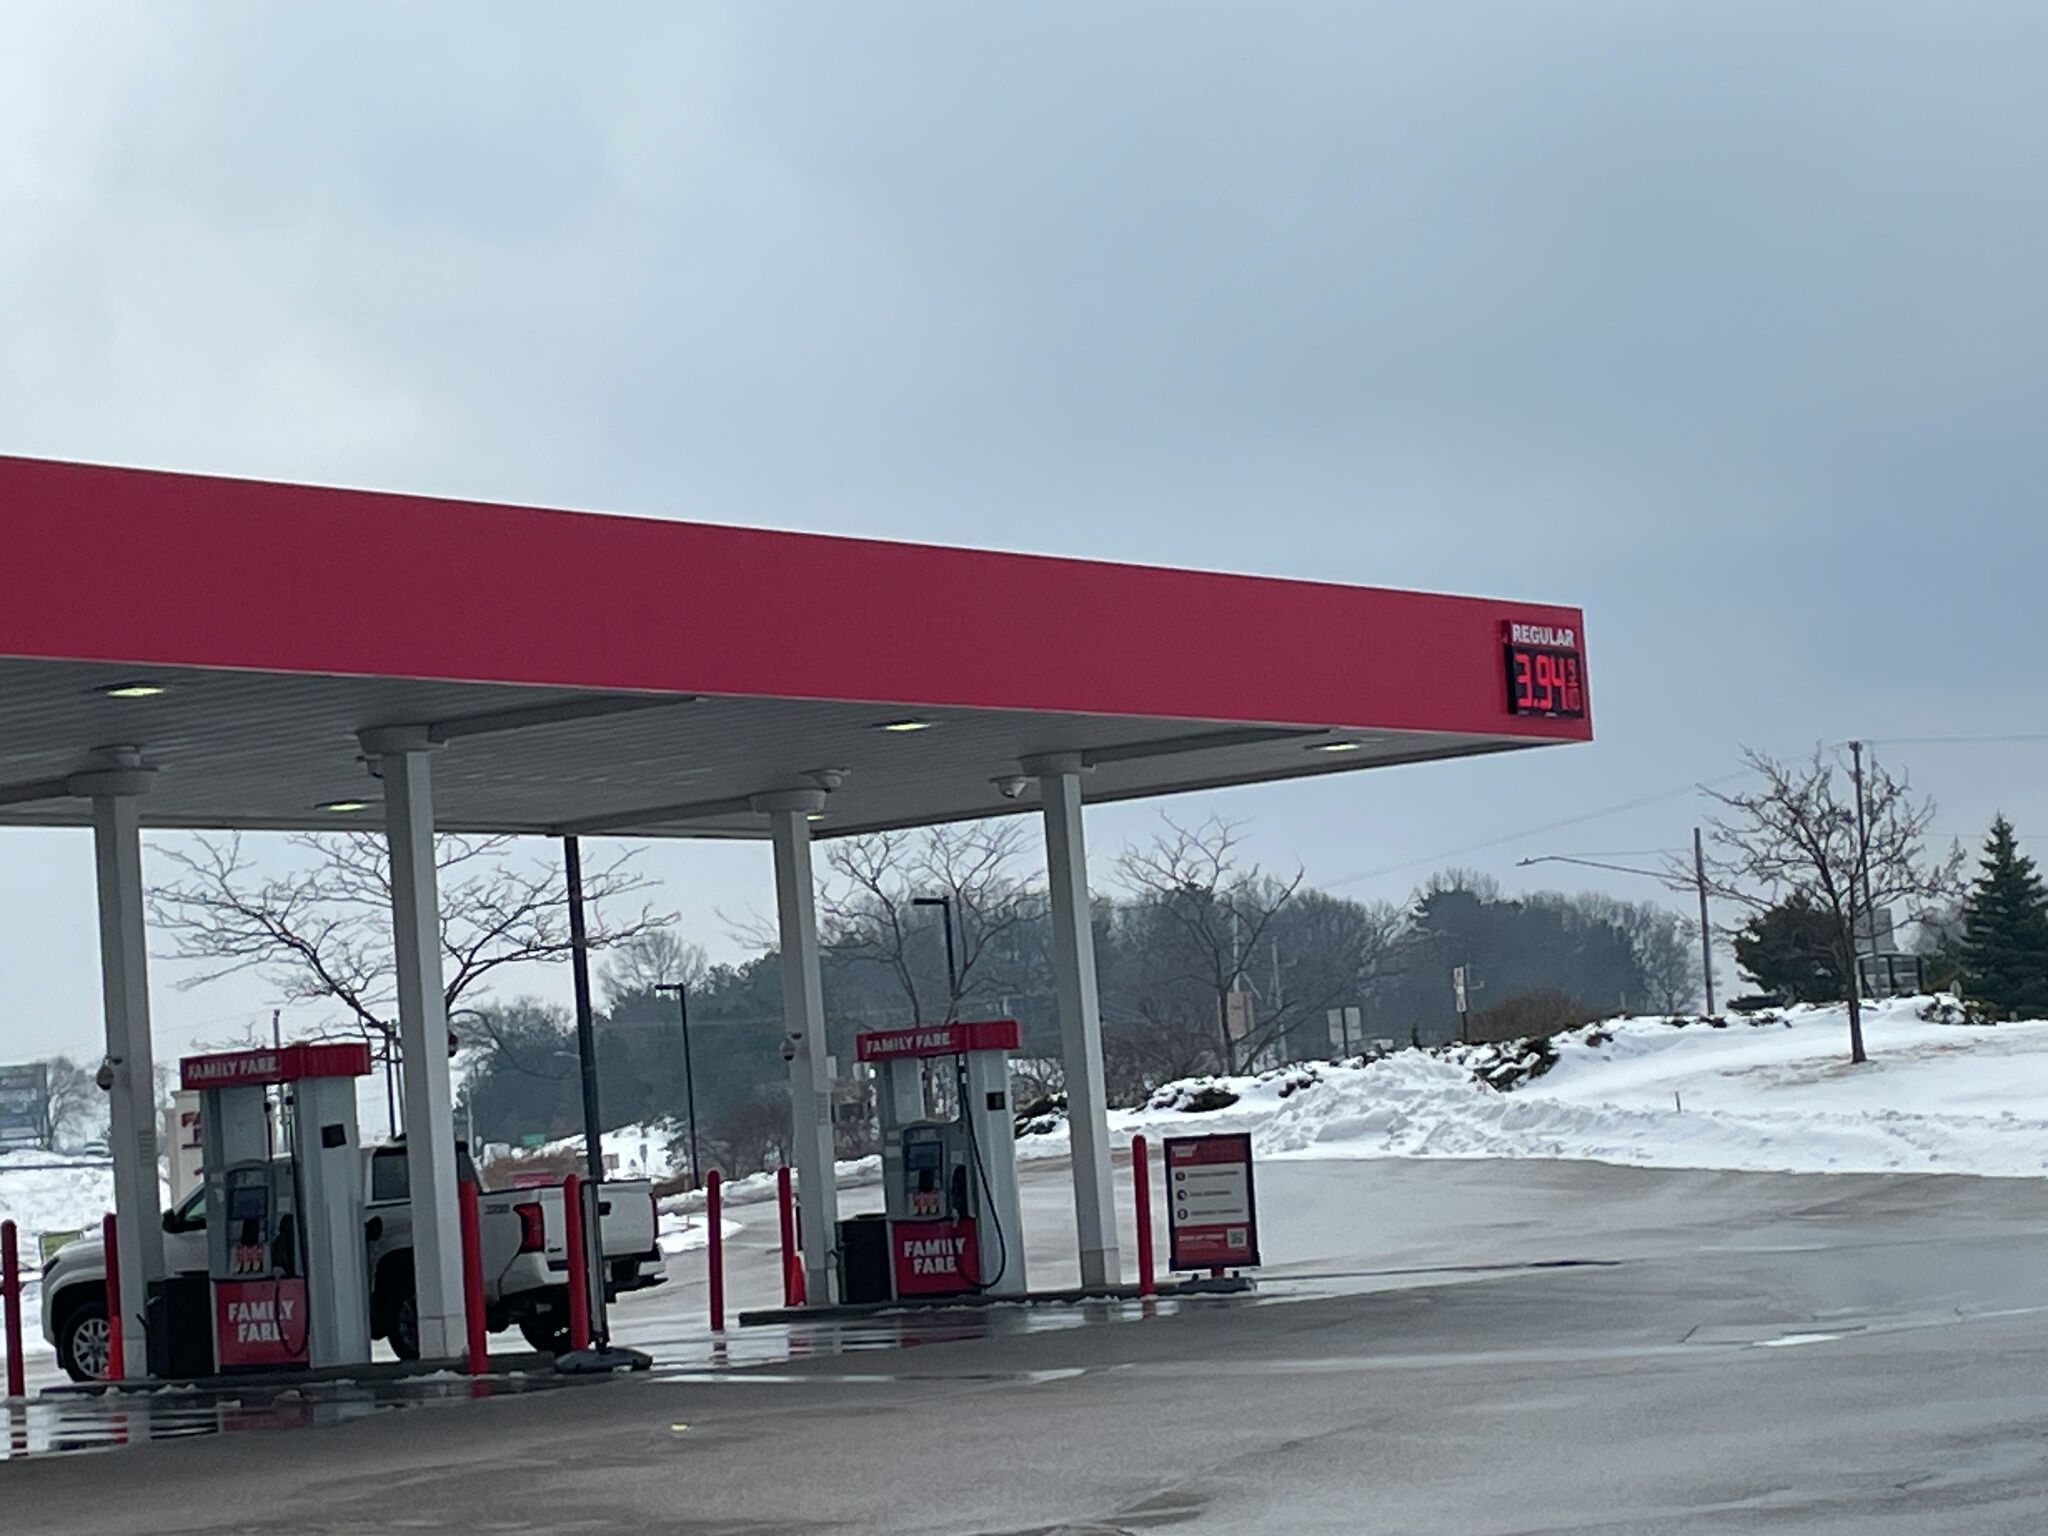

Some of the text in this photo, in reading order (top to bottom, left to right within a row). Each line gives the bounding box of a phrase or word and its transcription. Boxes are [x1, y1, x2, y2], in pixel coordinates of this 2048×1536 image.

[1511, 623, 1575, 648] REGULAR
[866, 1032, 951, 1053] FAMILY FARE
[187, 1055, 276, 1080] FAMILY FARE
[913, 1255, 958, 1275] FARE
